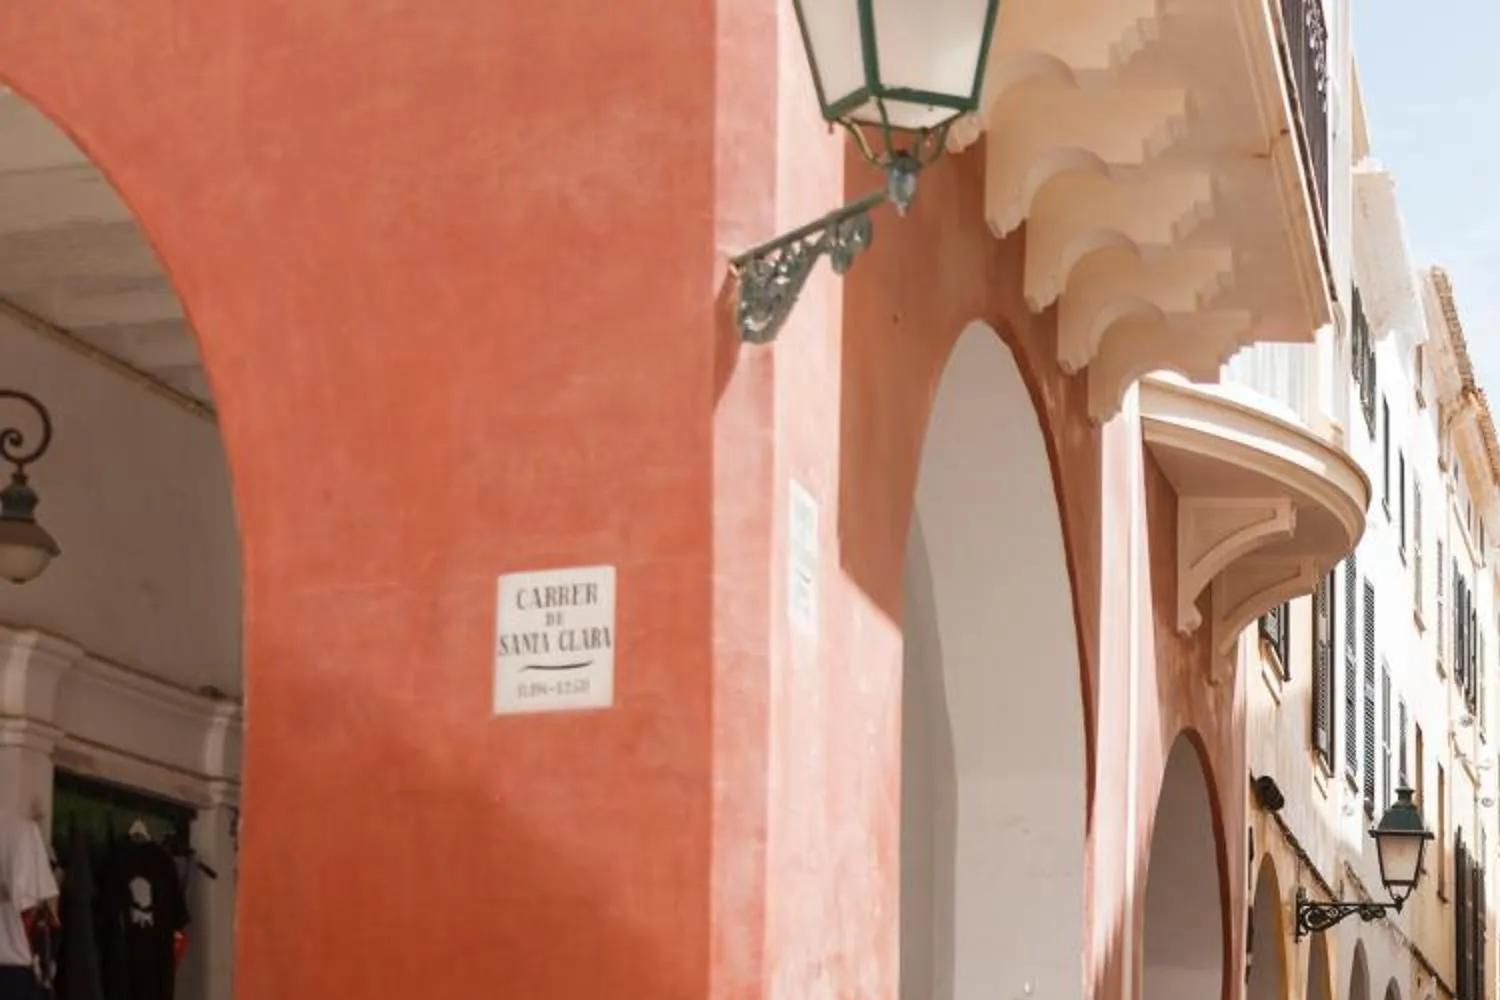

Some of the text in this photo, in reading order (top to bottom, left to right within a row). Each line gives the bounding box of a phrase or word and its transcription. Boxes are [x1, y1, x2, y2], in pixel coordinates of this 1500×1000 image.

[516, 583, 598, 610] CARRER
[499, 626, 611, 656] SANTA CLARA
